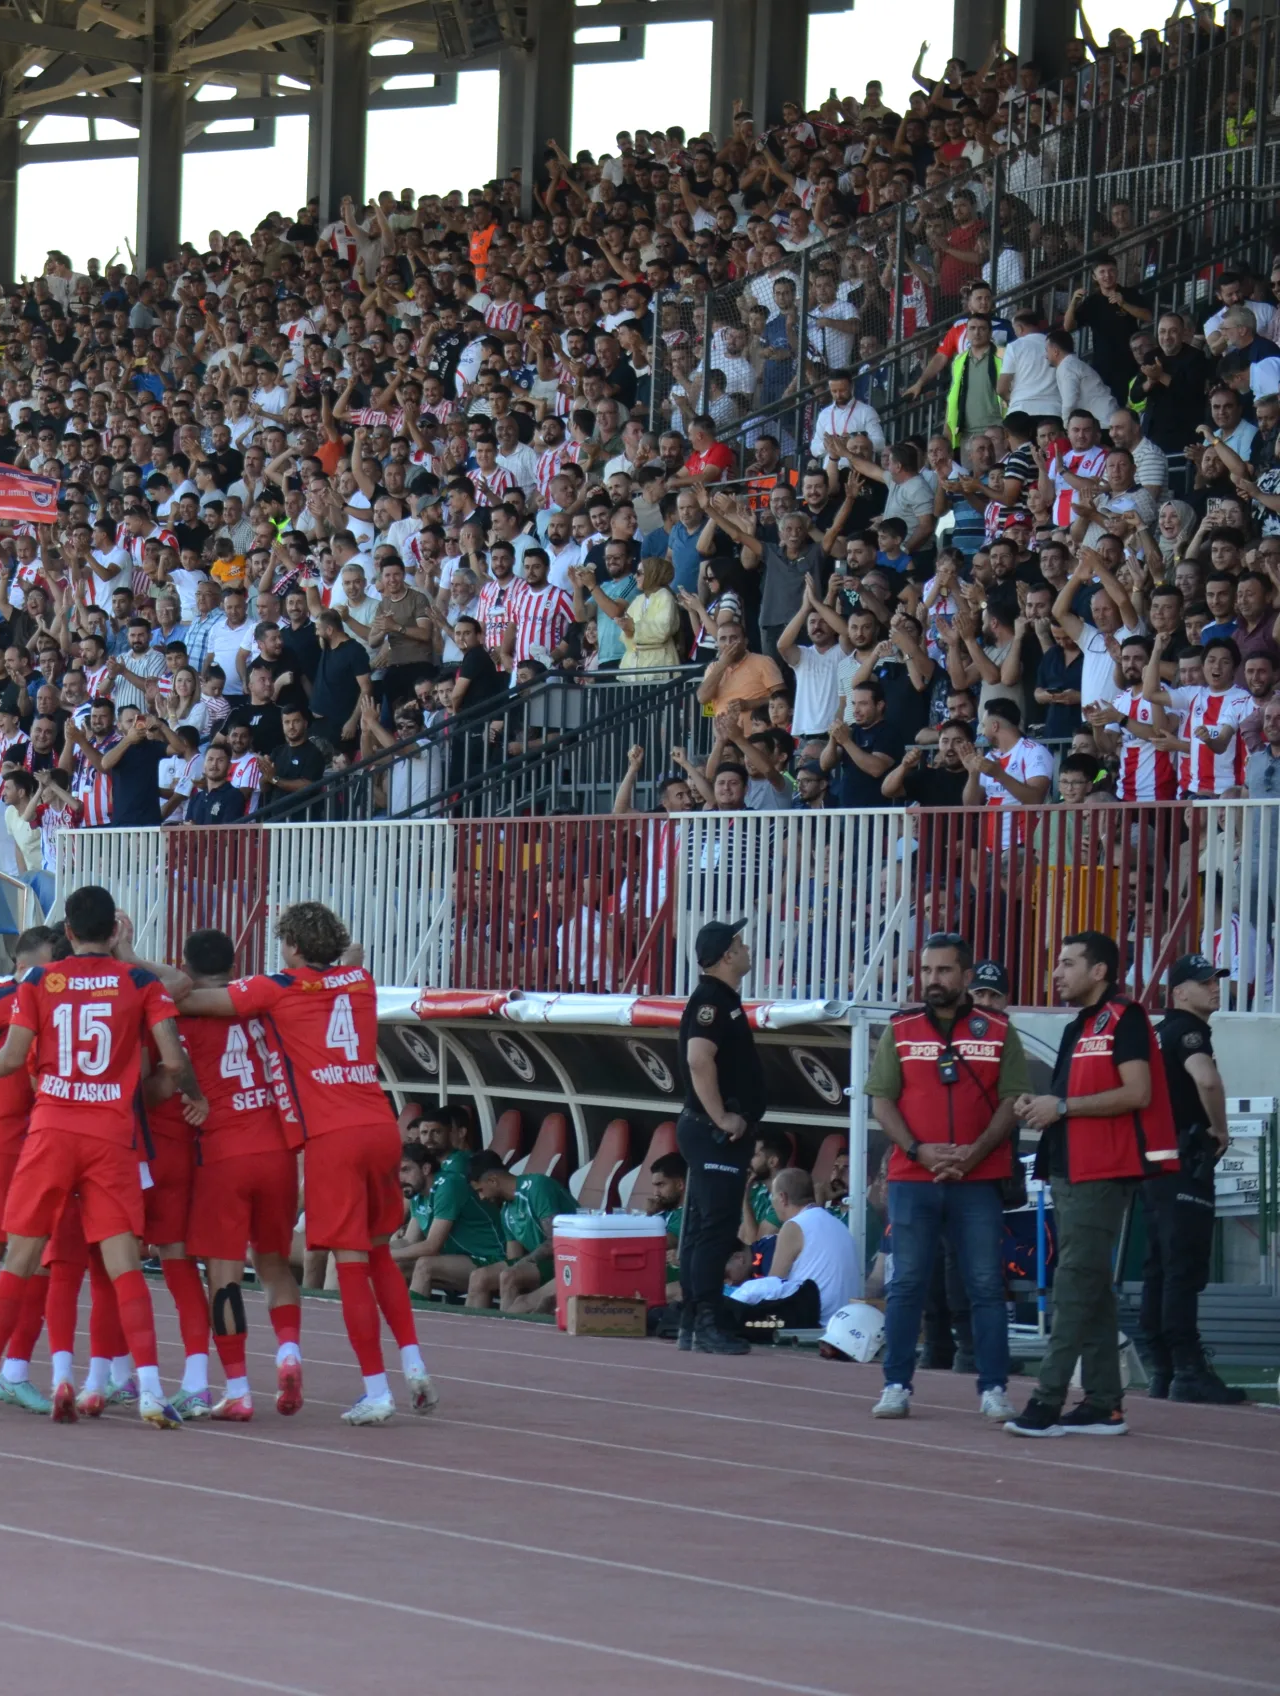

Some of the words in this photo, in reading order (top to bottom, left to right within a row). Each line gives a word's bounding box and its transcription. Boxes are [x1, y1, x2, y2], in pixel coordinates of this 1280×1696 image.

[52, 1002, 113, 1077] 15
[326, 993, 360, 1061] 4
[909, 1045, 939, 1056] SPOR
[959, 1043, 995, 1056] POLİSİ
[40, 1073, 71, 1099] BERK
[73, 1082, 121, 1103] TAŞKIN
[231, 1088, 276, 1111] SEFA
